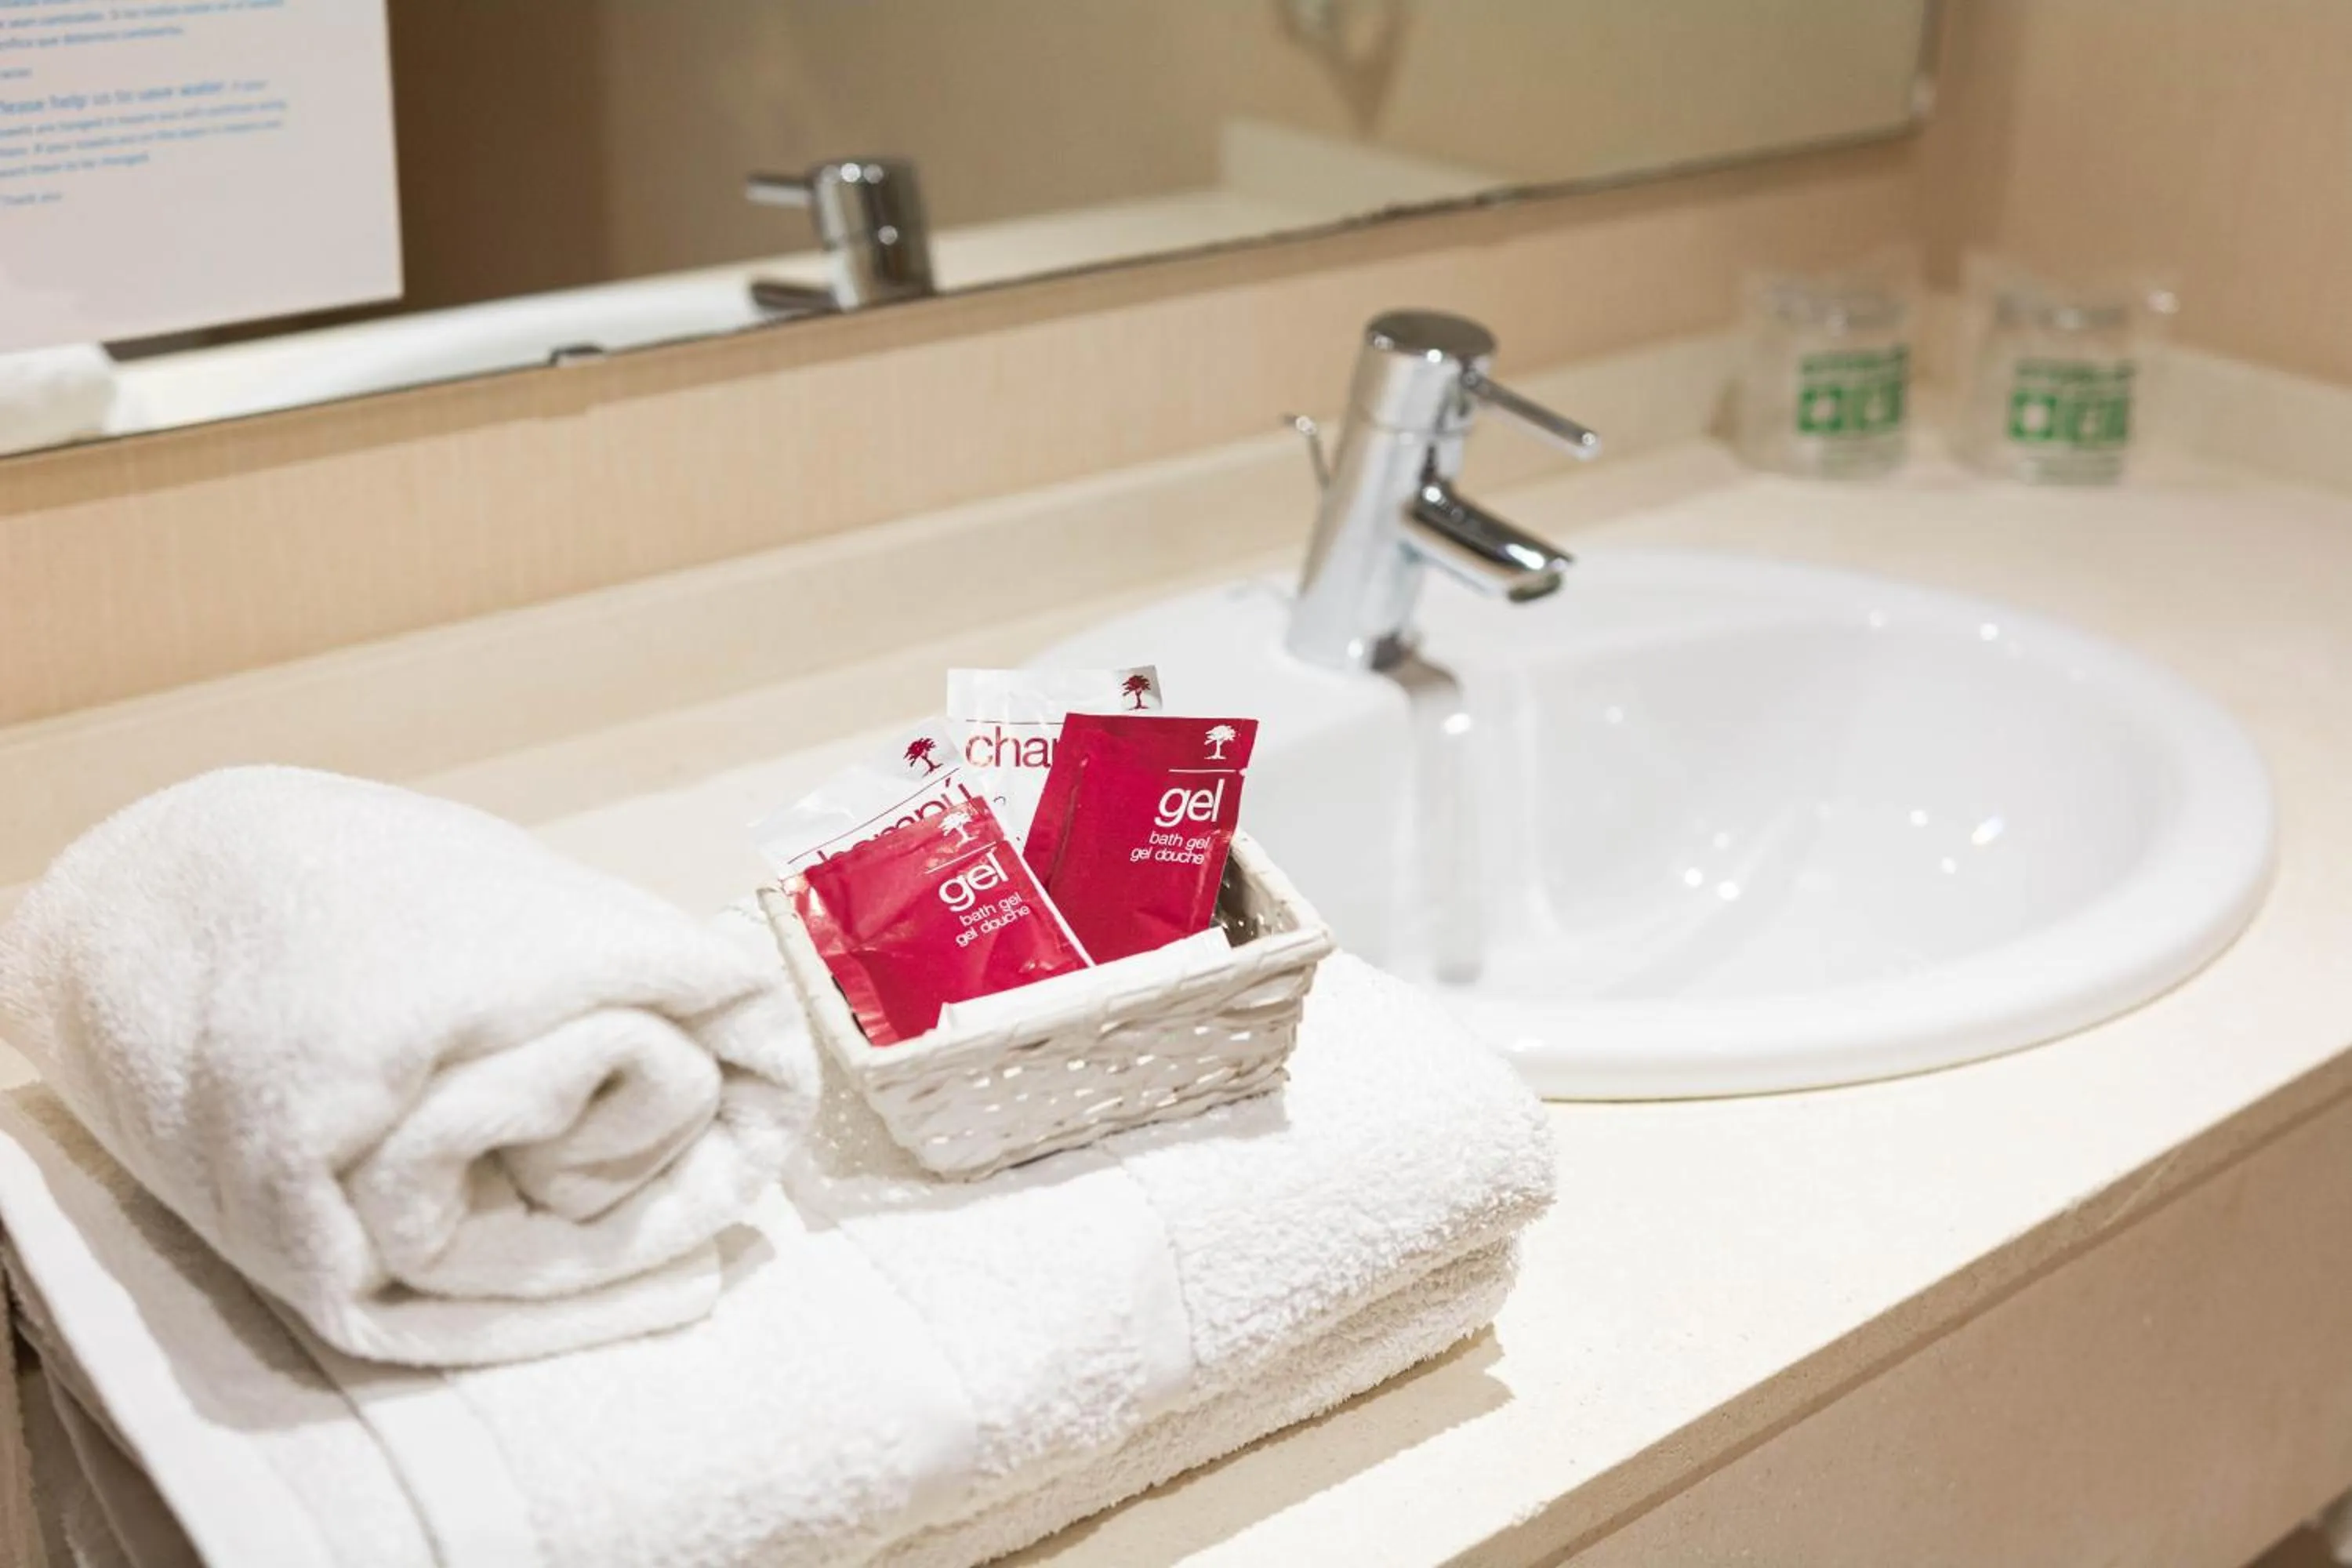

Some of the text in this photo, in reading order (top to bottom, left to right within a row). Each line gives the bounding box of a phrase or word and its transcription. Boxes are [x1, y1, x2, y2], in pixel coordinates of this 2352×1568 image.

[964, 725, 1059, 768] cha
[1154, 779, 1225, 827] gel
[1130, 847, 1205, 865] gel douche
[1149, 831, 1210, 851] bath gel
[938, 850, 1009, 913] gel
[956, 905, 1031, 948] gel douche
[959, 891, 1023, 927] bath gel
